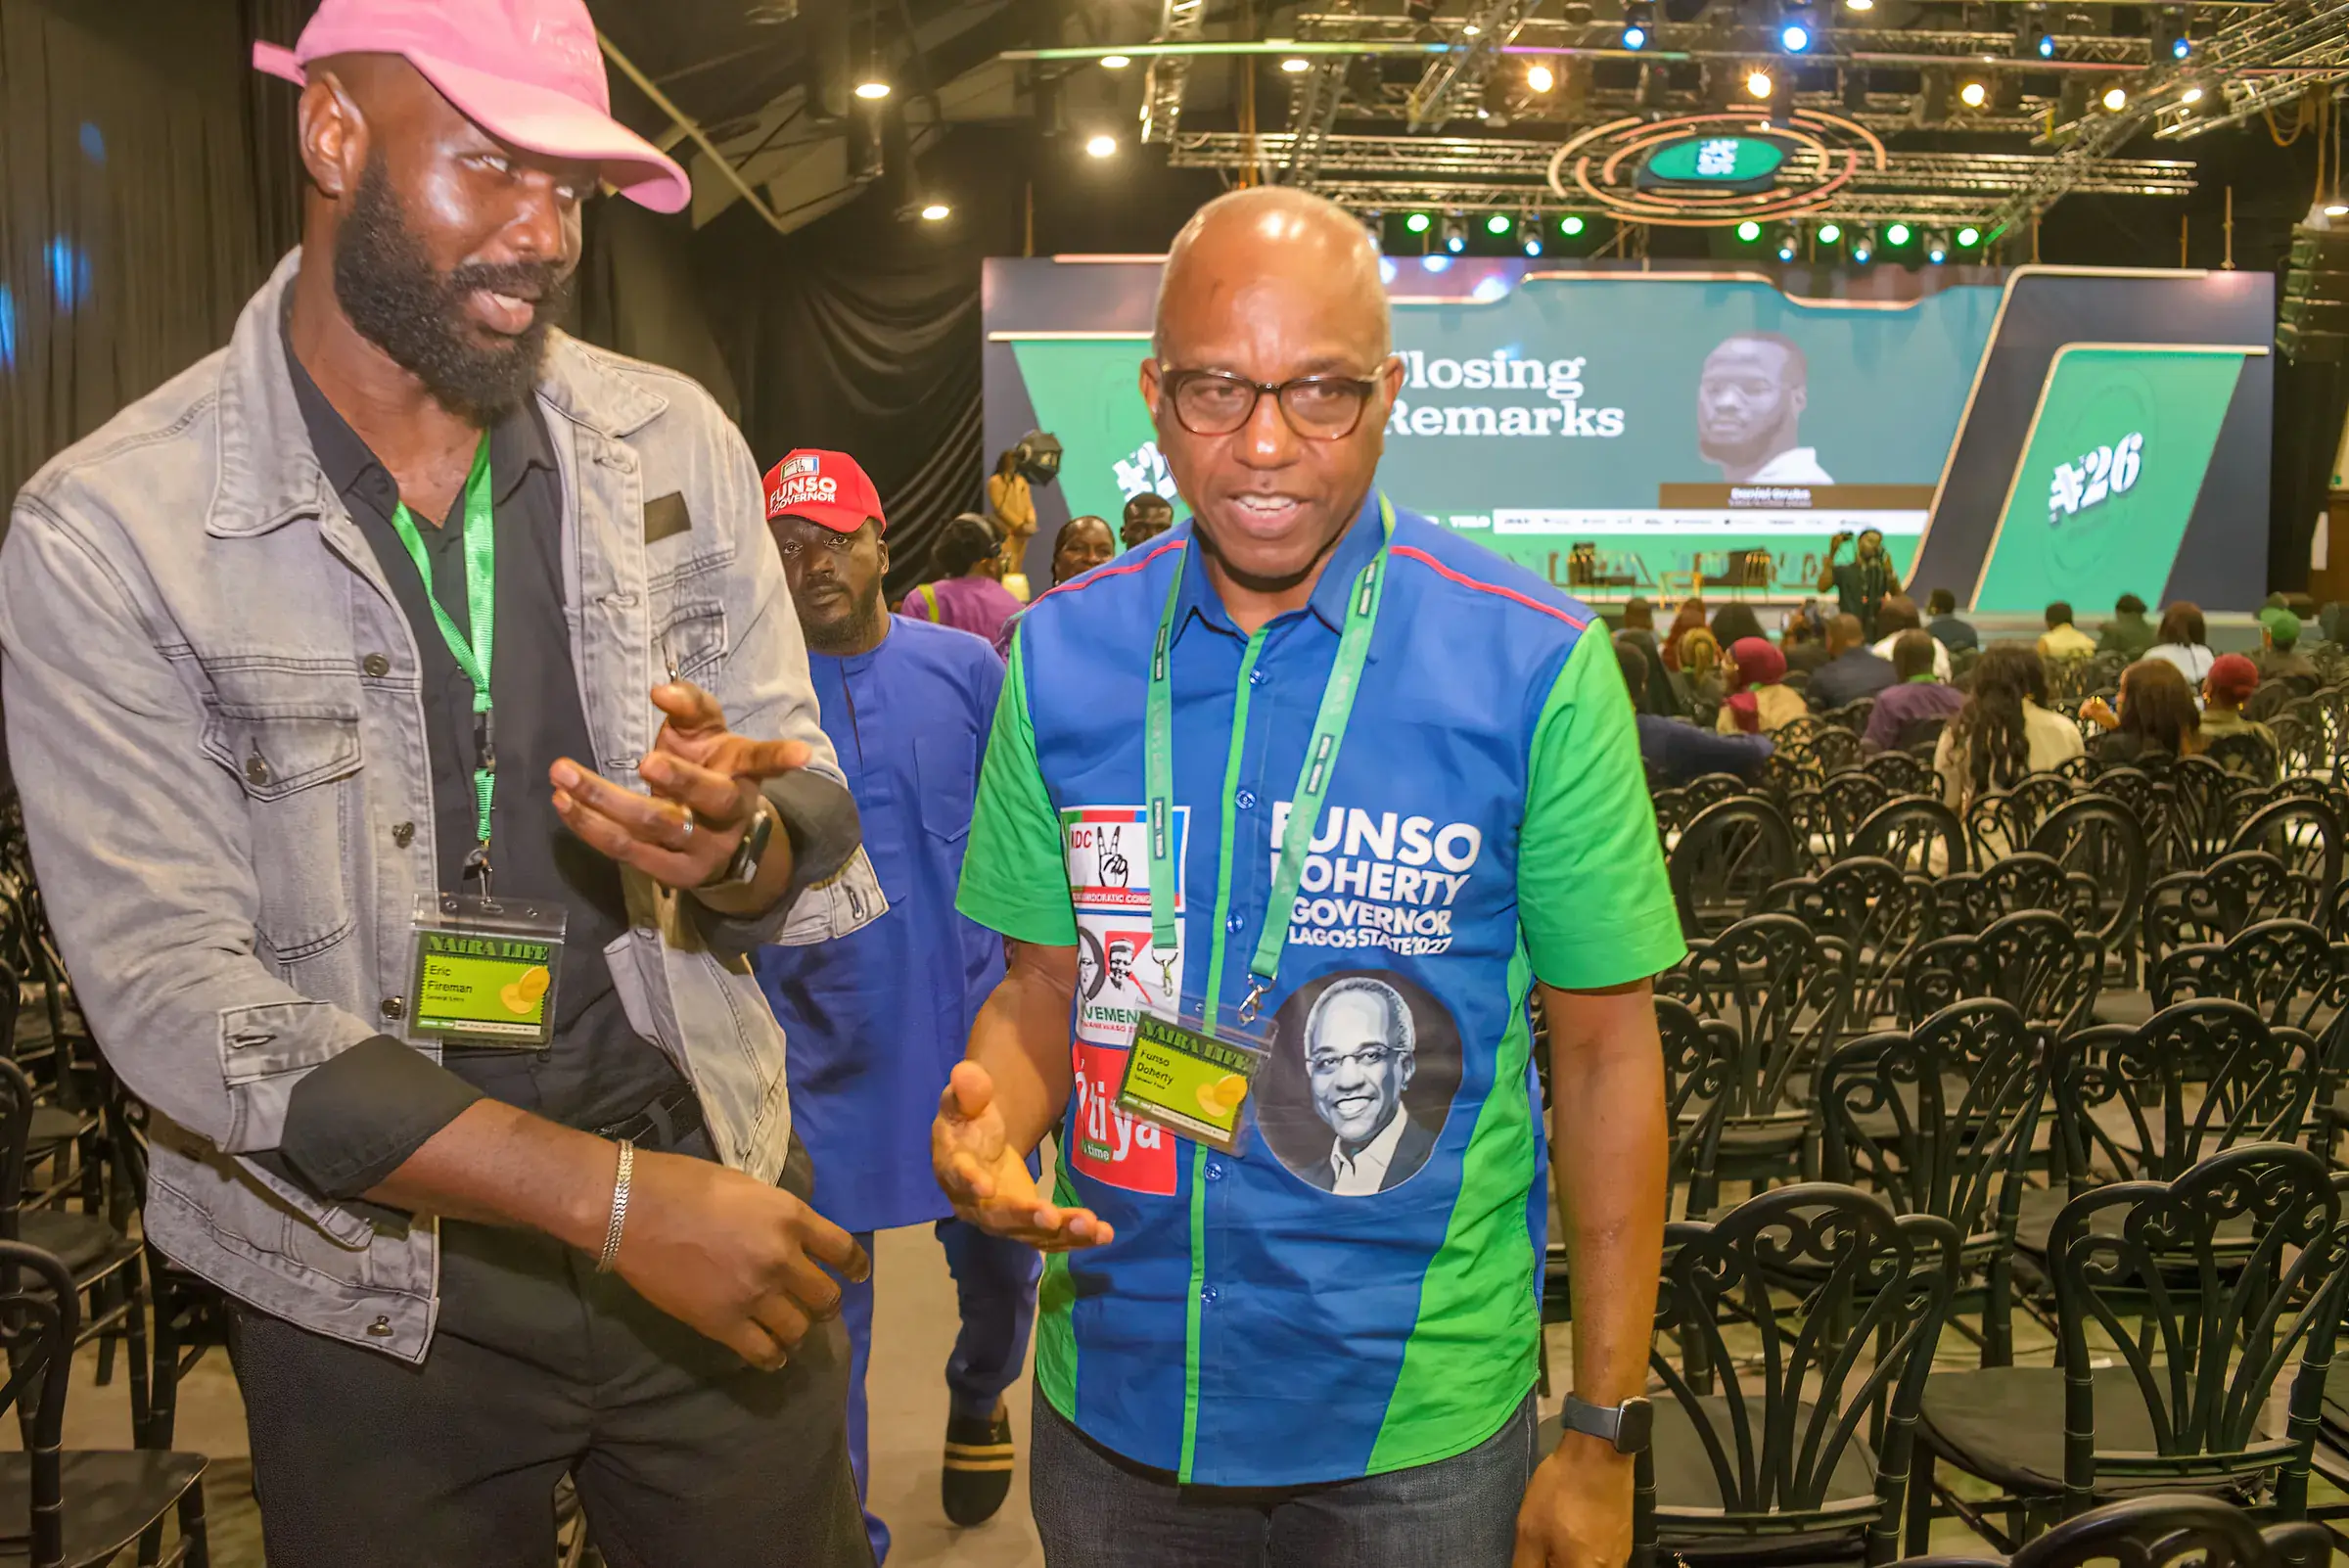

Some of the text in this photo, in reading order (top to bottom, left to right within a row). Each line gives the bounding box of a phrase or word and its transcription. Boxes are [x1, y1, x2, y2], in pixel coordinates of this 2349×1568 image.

[770, 476, 838, 509] FUNSO
[1270, 852, 1472, 906] OHERTY
[1290, 896, 1452, 936] GOVERNOR
[429, 935, 550, 962] NAIRA LIFE
[1288, 925, 1358, 949] LAGOS
[429, 964, 452, 977] Eric
[427, 979, 473, 994] Fireman
[1140, 1048, 1171, 1067] Funso
[1136, 1061, 1174, 1085] Doherty
